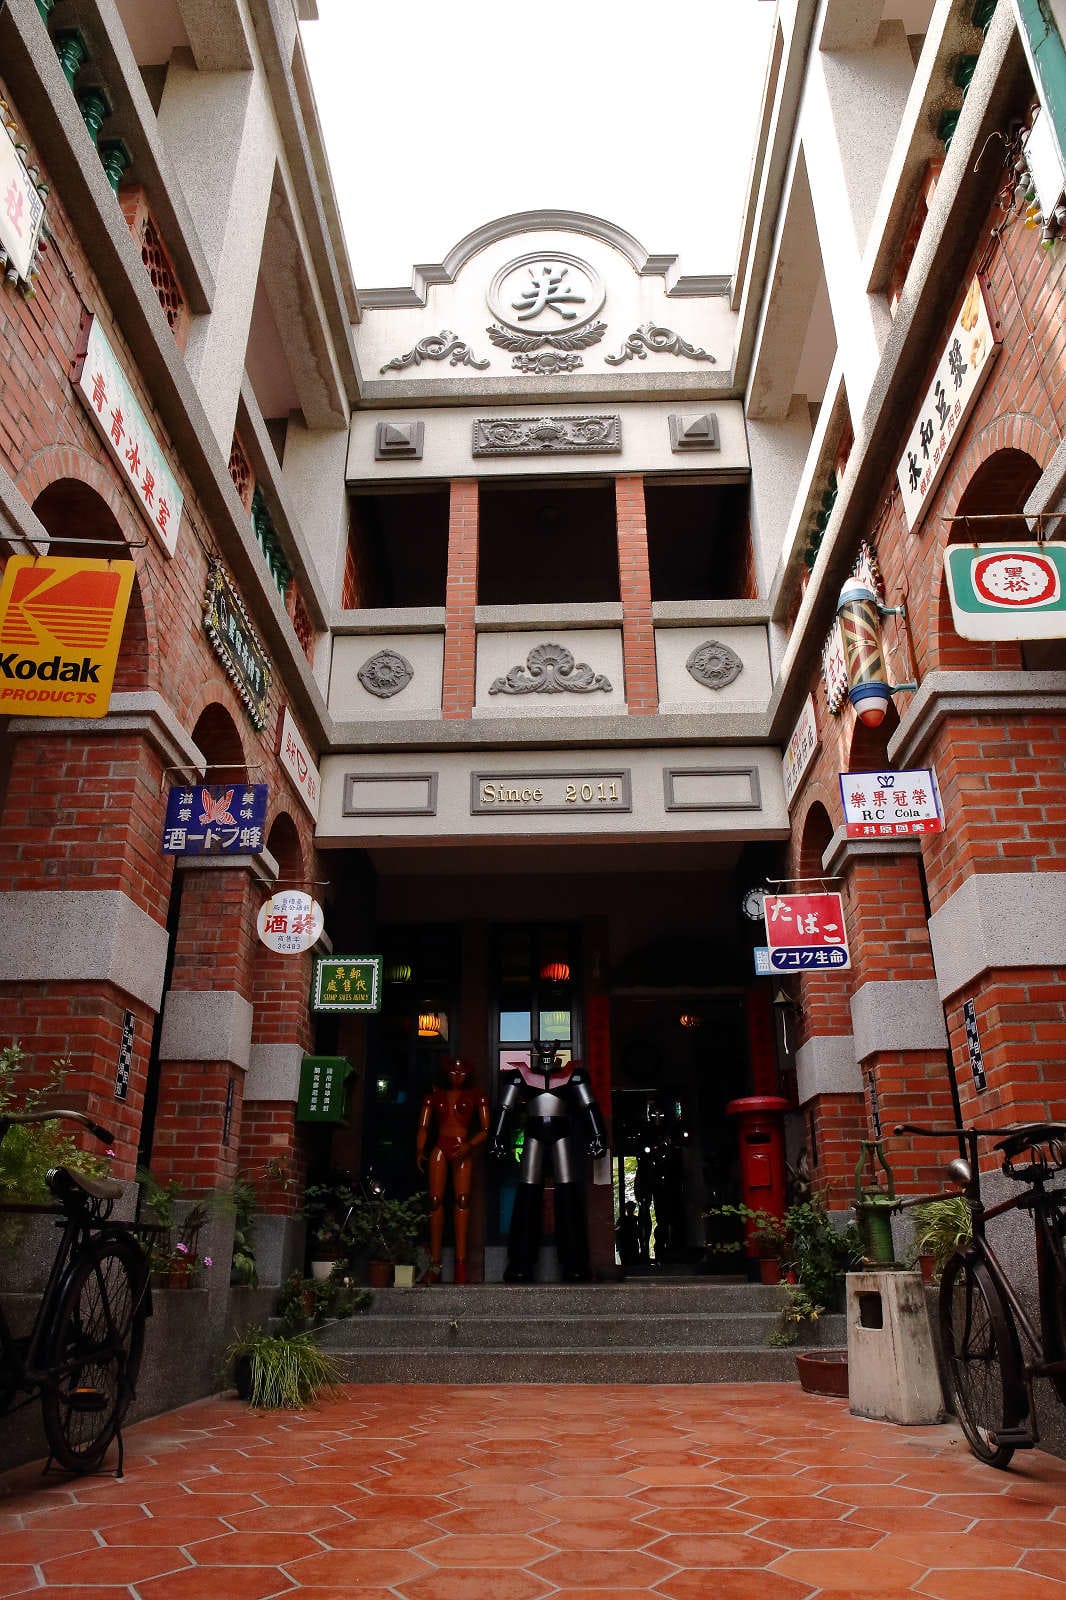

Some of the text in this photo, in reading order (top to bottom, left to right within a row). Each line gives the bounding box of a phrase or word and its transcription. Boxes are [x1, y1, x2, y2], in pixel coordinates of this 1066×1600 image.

[91, 371, 171, 538] 青青冰果室
[1003, 566, 1031, 593] 黑松
[0, 653, 102, 684] Kodak
[0, 688, 97, 704] PRODUCTS
[481, 782, 619, 803] Since 2011
[894, 808, 920, 818] Cola
[770, 898, 842, 943] たばこ
[775, 949, 844, 965] フコク生命
